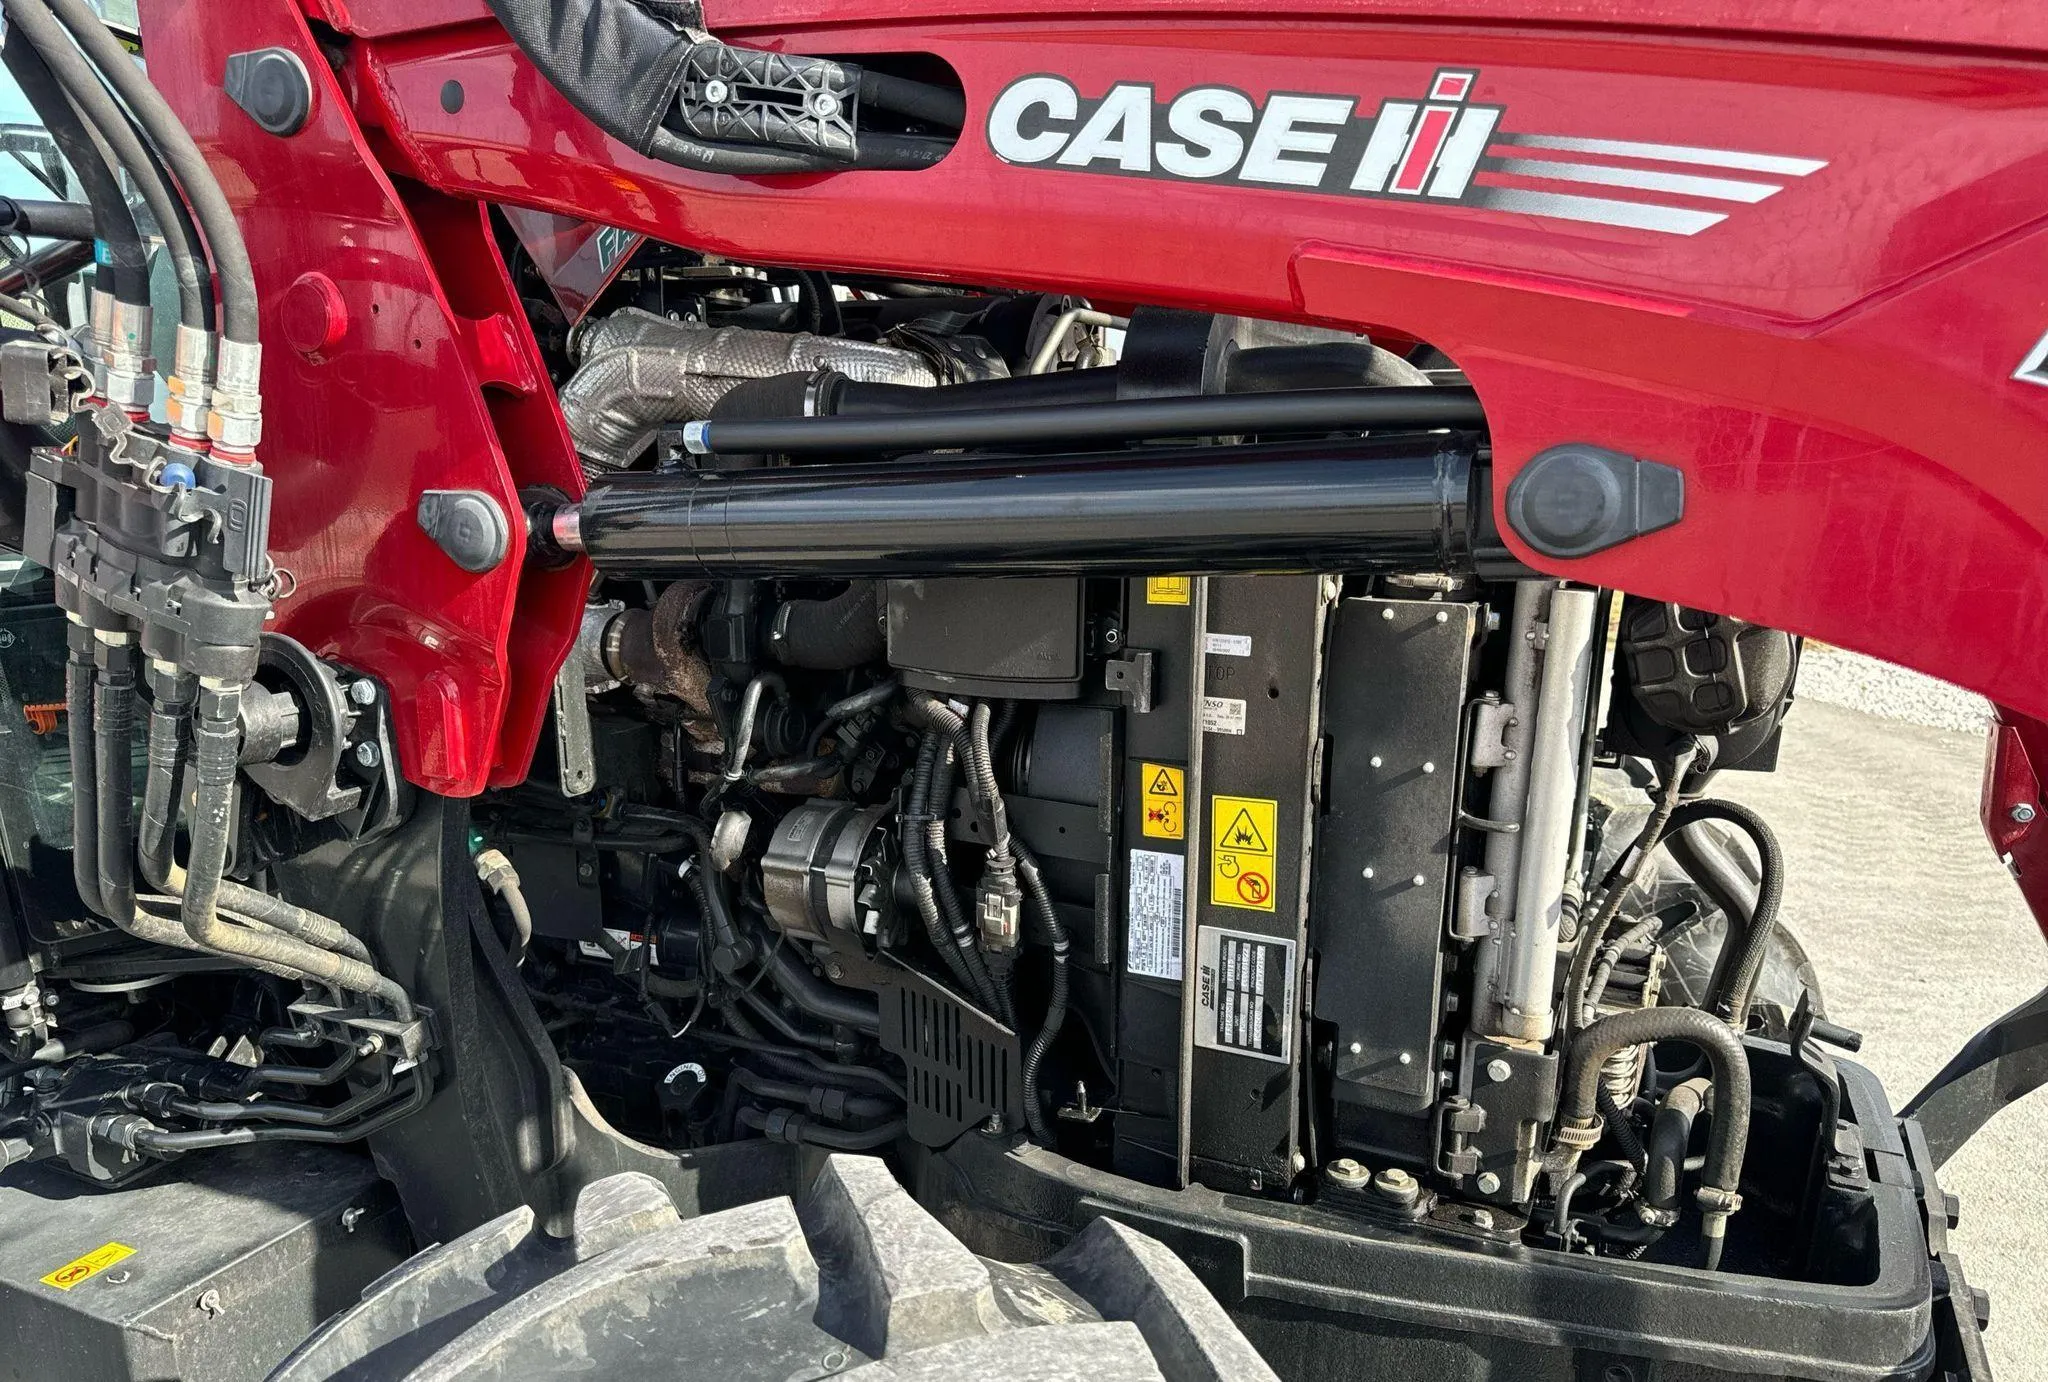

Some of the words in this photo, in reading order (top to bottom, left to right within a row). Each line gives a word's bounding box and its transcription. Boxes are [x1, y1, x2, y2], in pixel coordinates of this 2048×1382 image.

[988, 76, 1355, 188] CASE
[1203, 700, 1224, 709] NSO
[1201, 976, 1210, 1007] CASE
